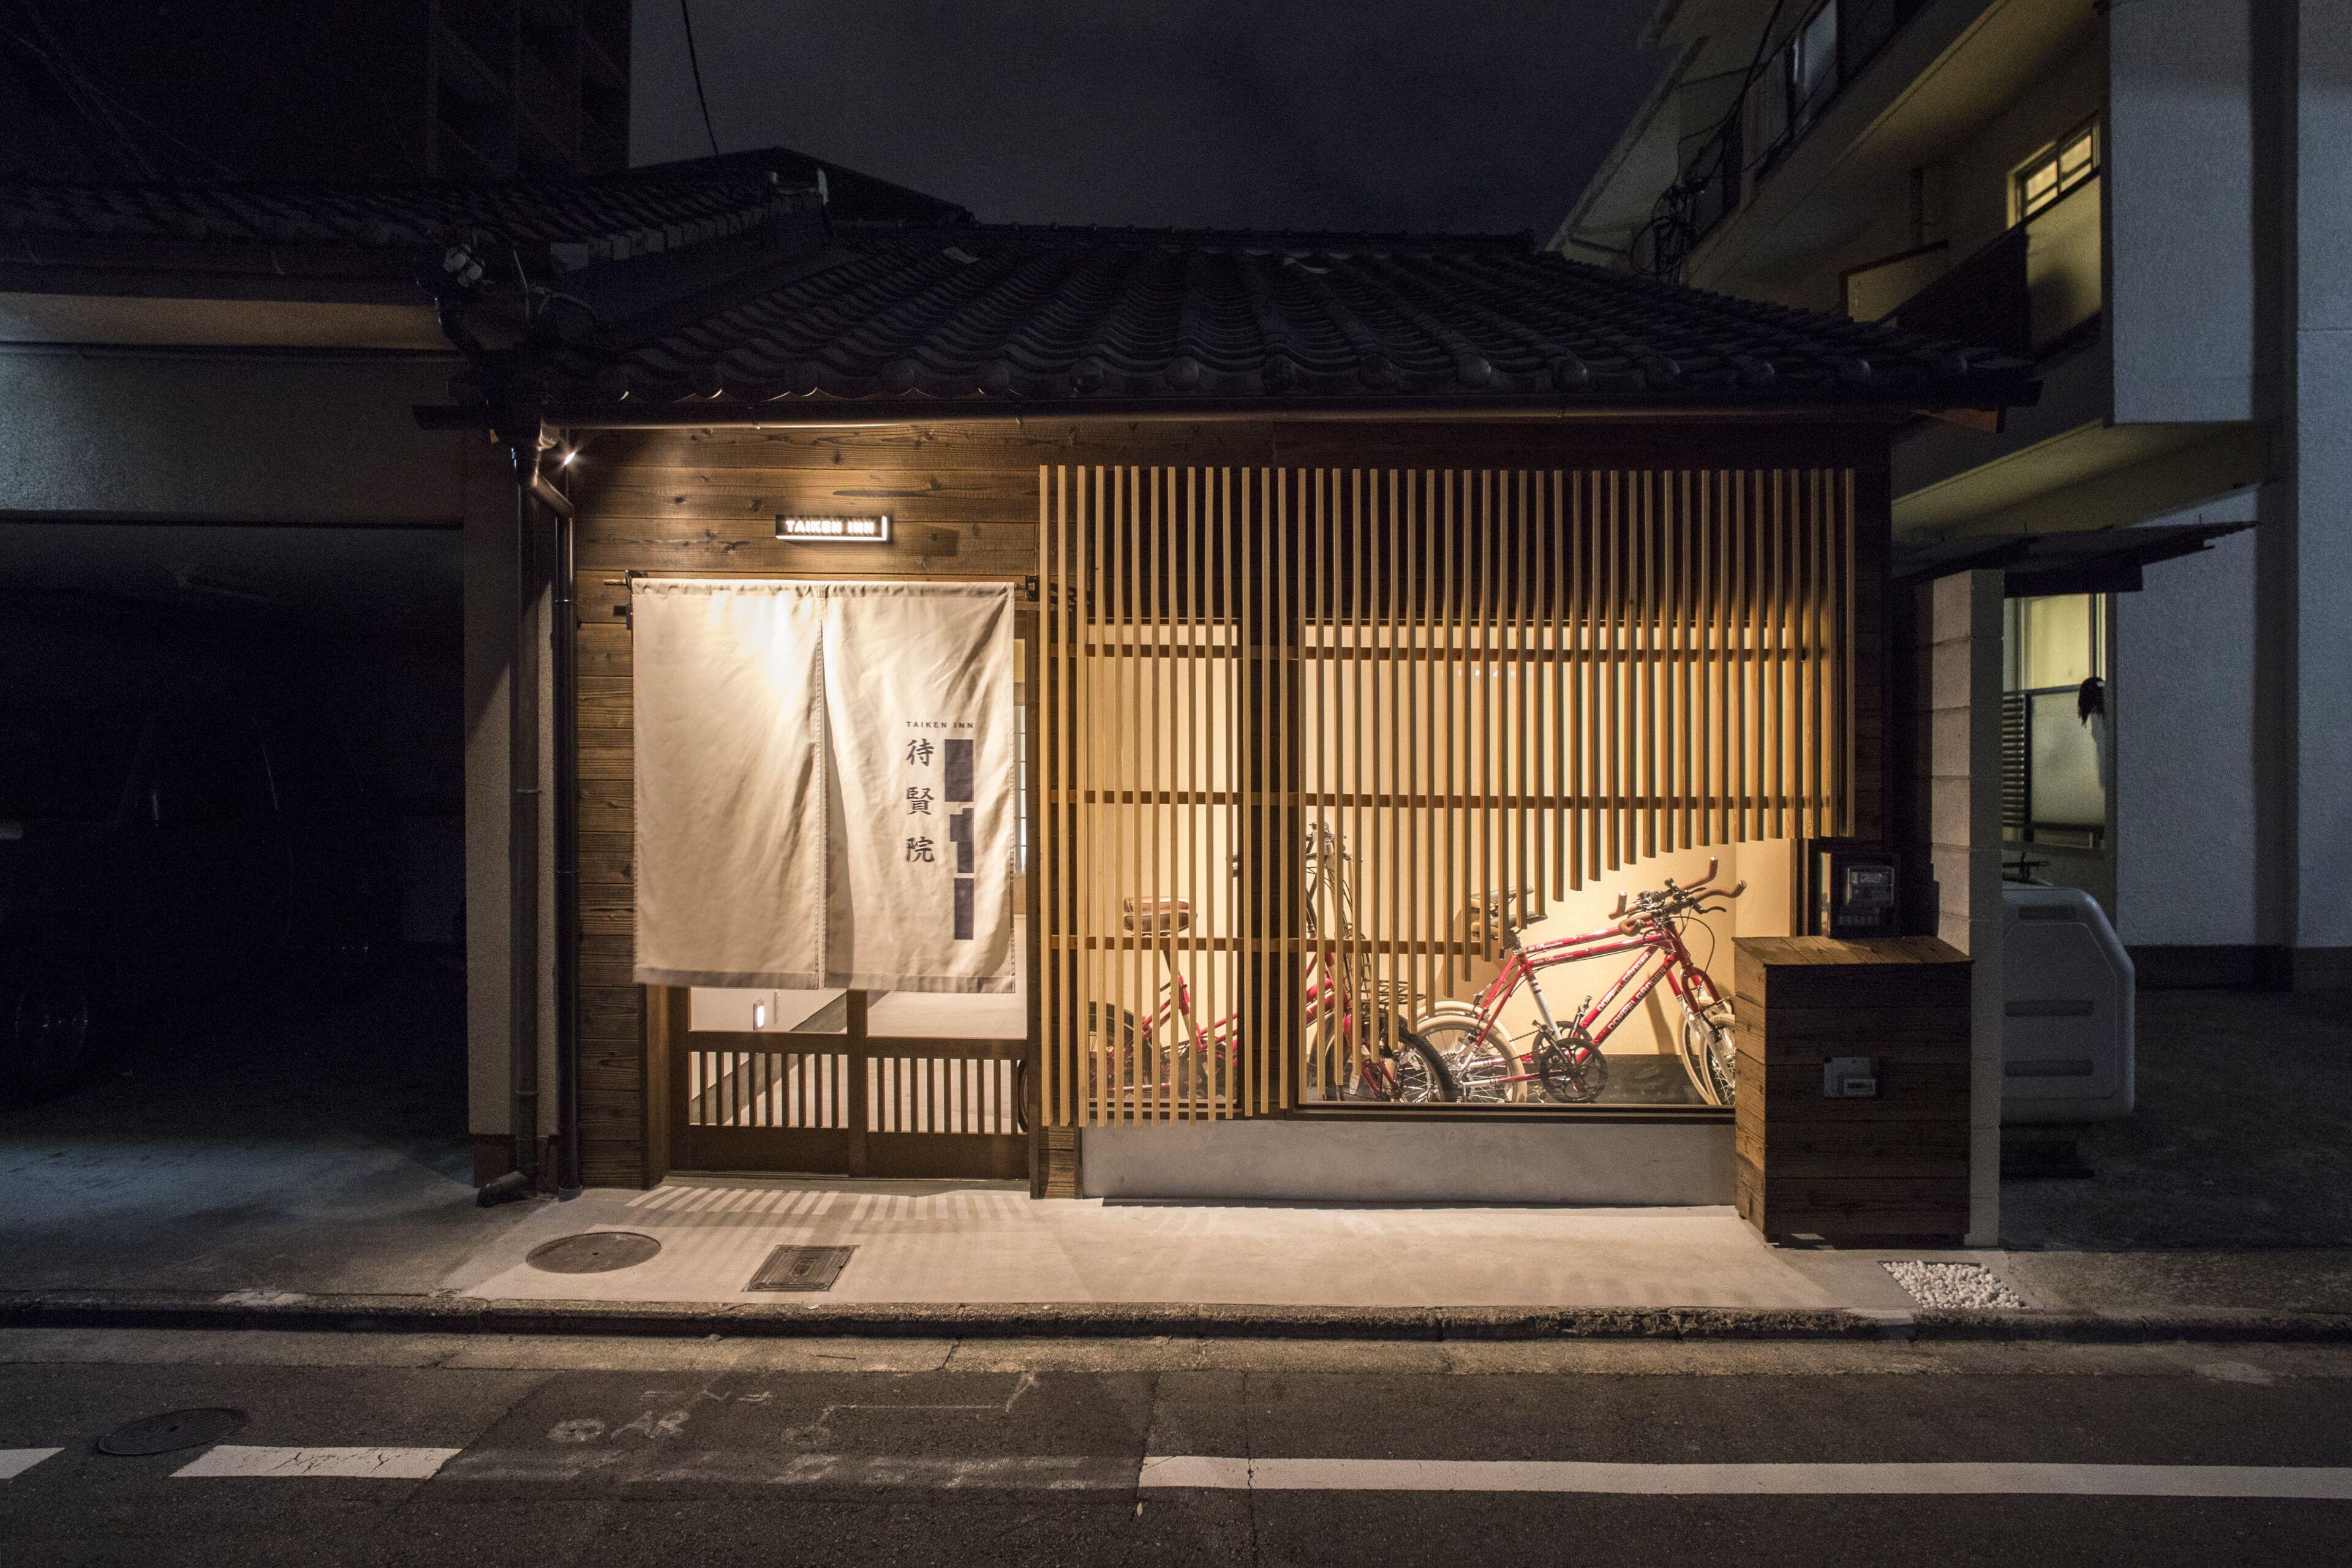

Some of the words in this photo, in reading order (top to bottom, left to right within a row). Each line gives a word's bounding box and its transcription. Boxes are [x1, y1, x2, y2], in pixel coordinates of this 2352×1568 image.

[785, 520, 842, 533] TAIKEN
[847, 521, 875, 534] INN
[906, 738, 935, 863] 待賢院
